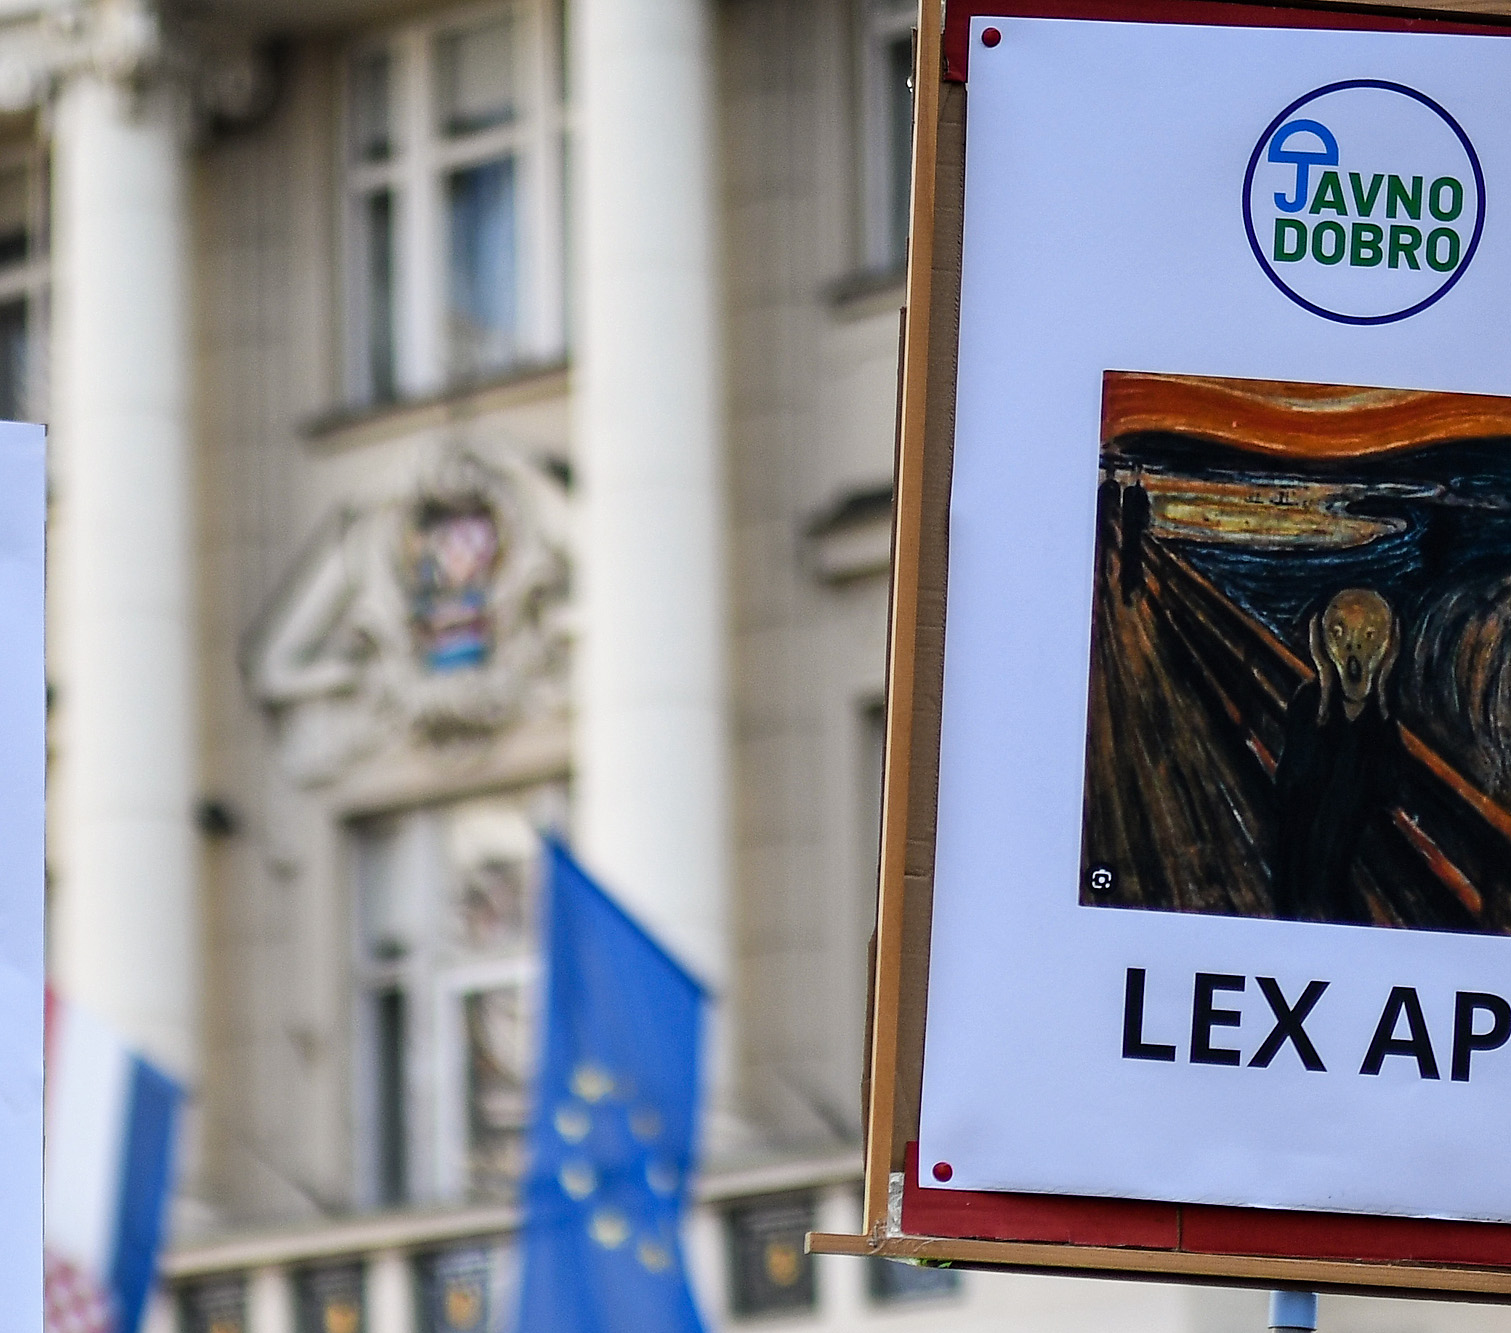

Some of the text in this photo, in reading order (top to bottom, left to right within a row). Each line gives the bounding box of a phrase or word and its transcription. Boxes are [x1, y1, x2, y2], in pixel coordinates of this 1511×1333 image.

[1268, 135, 1464, 223] JAVNO
[1273, 219, 1460, 272] DOBRO
[1122, 968, 1511, 1082] LEX AP
